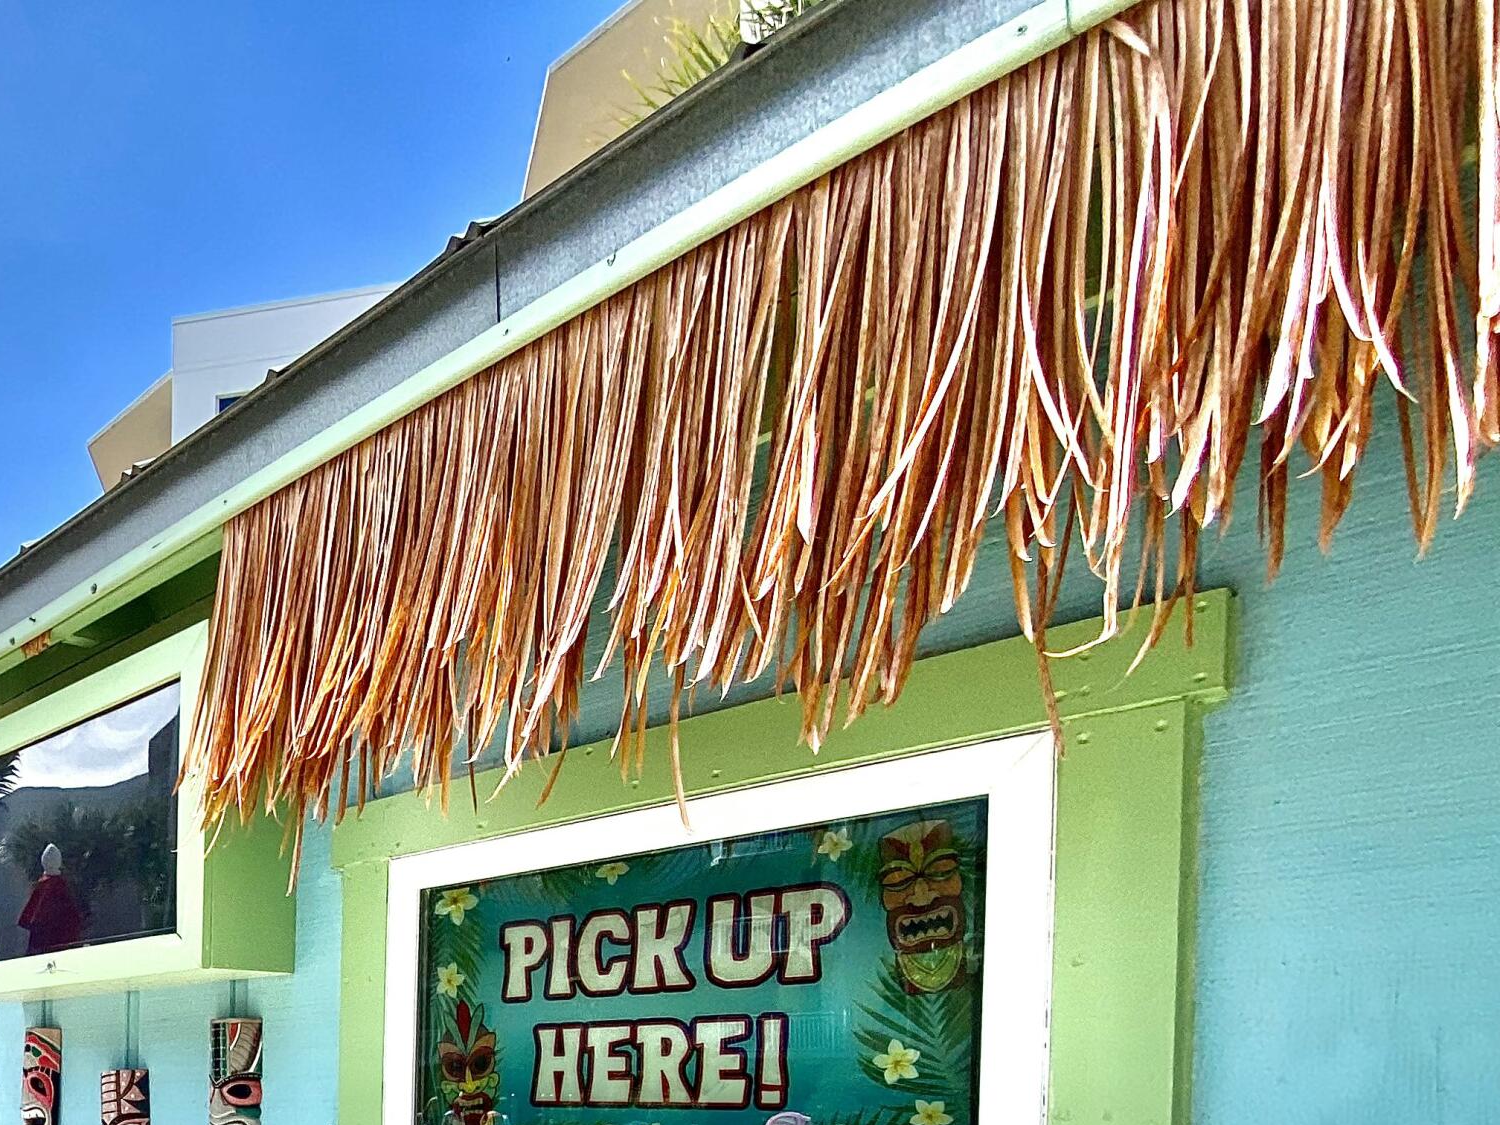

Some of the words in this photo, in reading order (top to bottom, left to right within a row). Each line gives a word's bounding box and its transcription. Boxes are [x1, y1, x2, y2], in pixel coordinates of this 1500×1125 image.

[501, 899, 696, 1003] PICK
[705, 881, 852, 988] UP
[531, 1012, 791, 1111] HERE!
